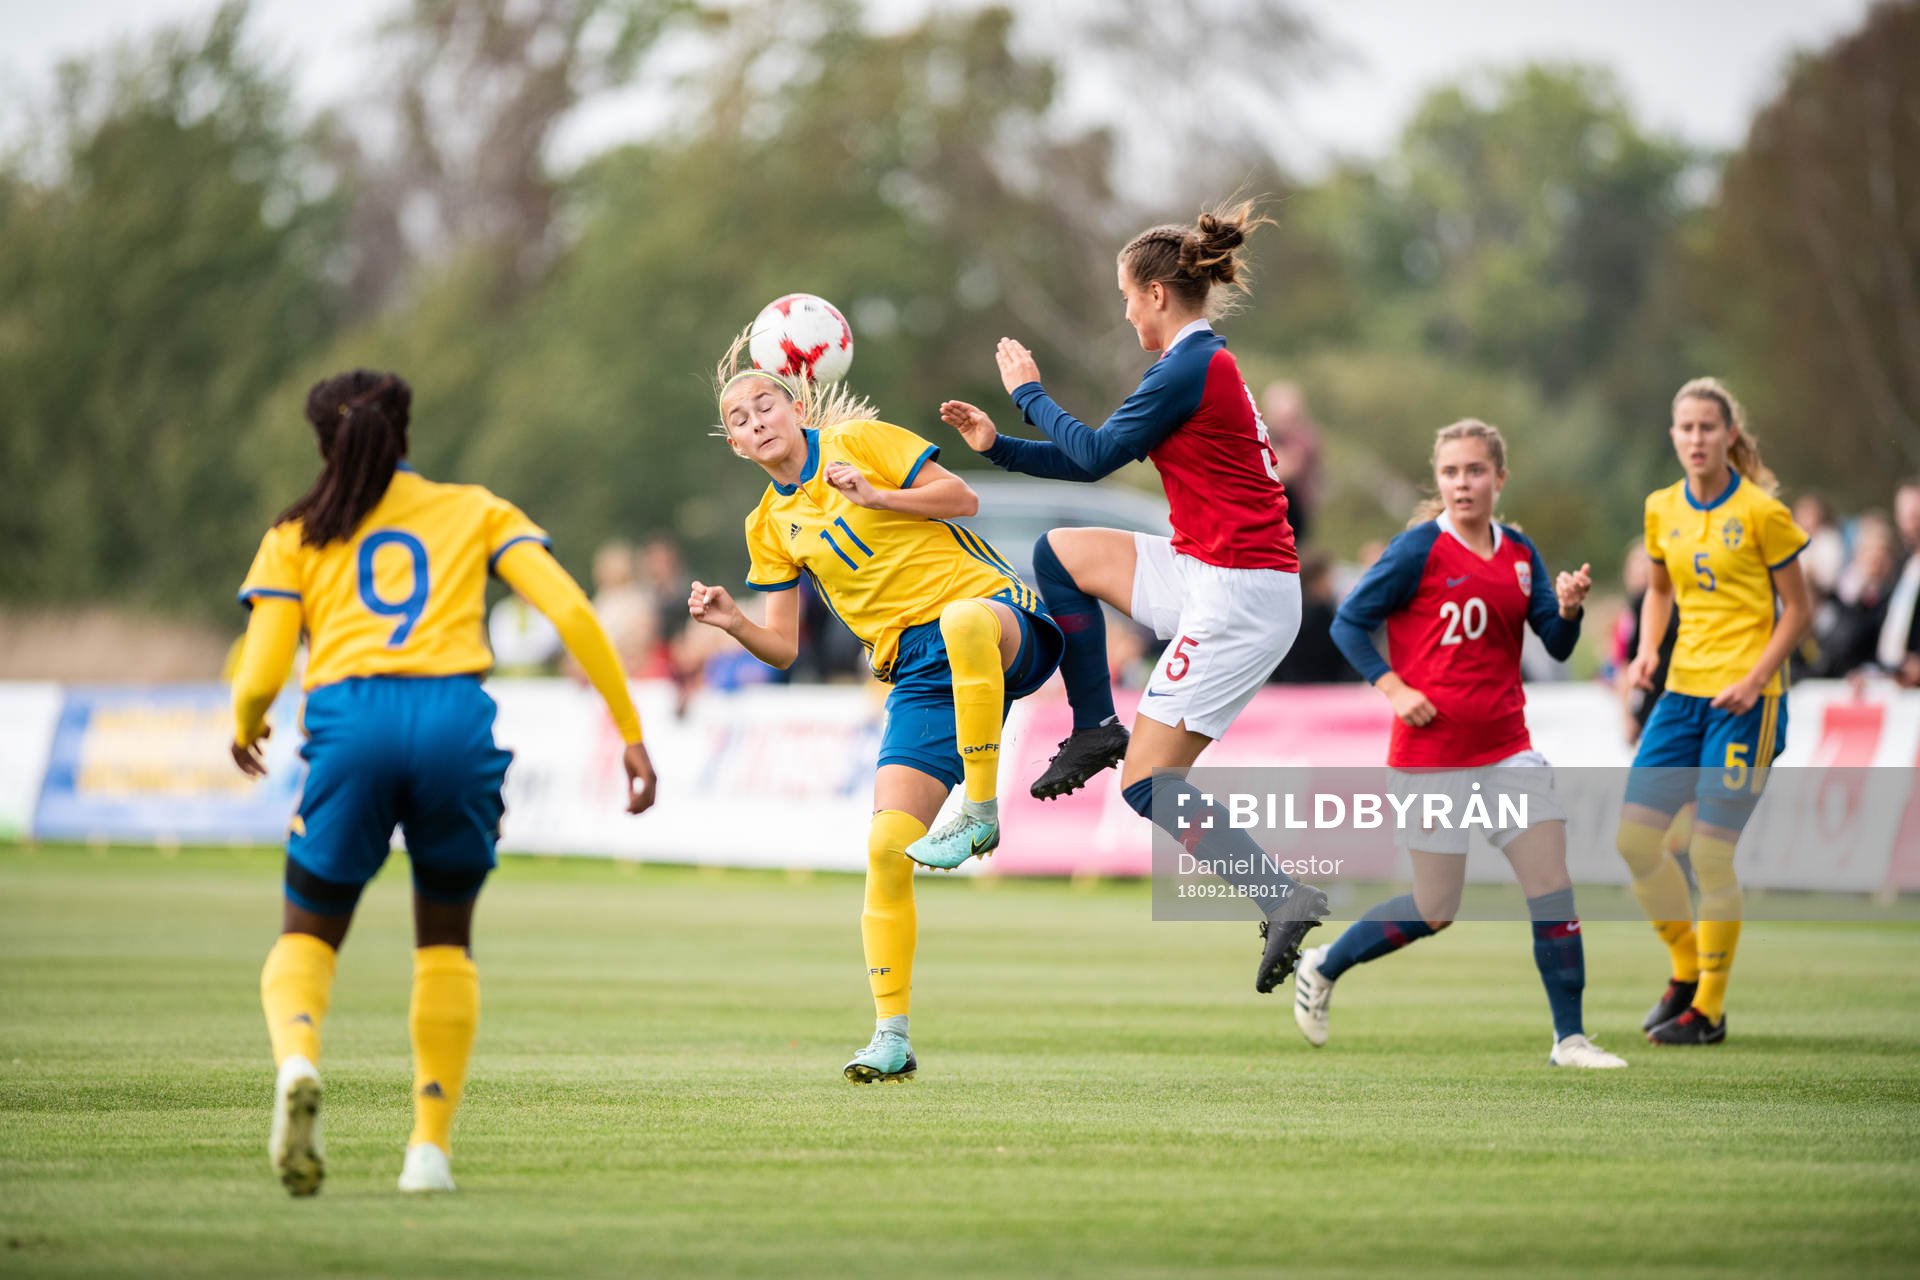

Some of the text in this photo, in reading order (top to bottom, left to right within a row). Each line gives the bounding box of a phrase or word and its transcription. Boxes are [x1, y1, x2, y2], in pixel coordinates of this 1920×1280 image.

[819, 515, 875, 572] 11
[358, 529, 429, 647] 9
[1694, 553, 1716, 591] 5
[1440, 597, 1487, 646] 20
[1166, 635, 1200, 682] 5
[1723, 743, 1748, 791] 5
